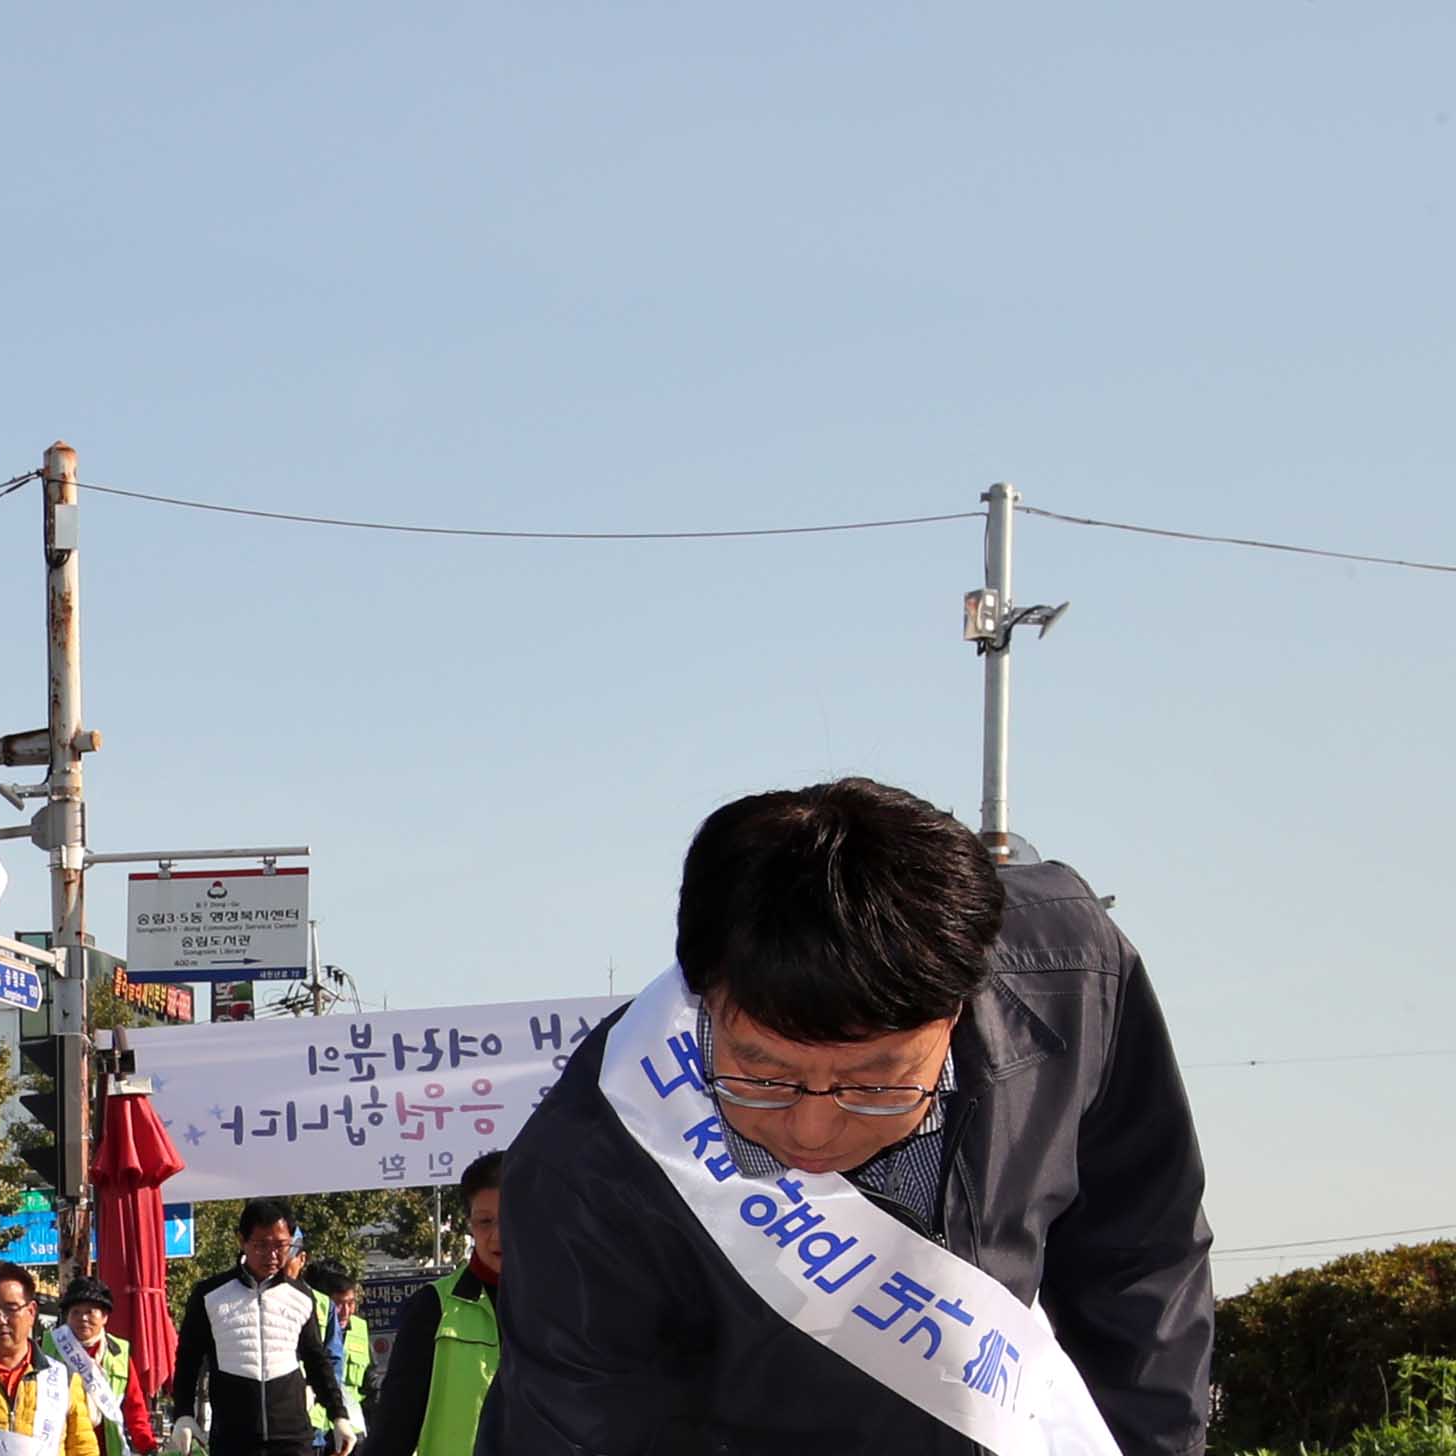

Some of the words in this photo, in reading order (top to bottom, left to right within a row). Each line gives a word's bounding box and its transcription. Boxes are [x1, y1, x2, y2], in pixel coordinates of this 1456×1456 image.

[209, 908, 300, 923] 행정복지센터
[181, 935, 251, 948] 송림도서관
[739, 1177, 876, 1296] 앞은
[852, 1271, 974, 1361] 내가
